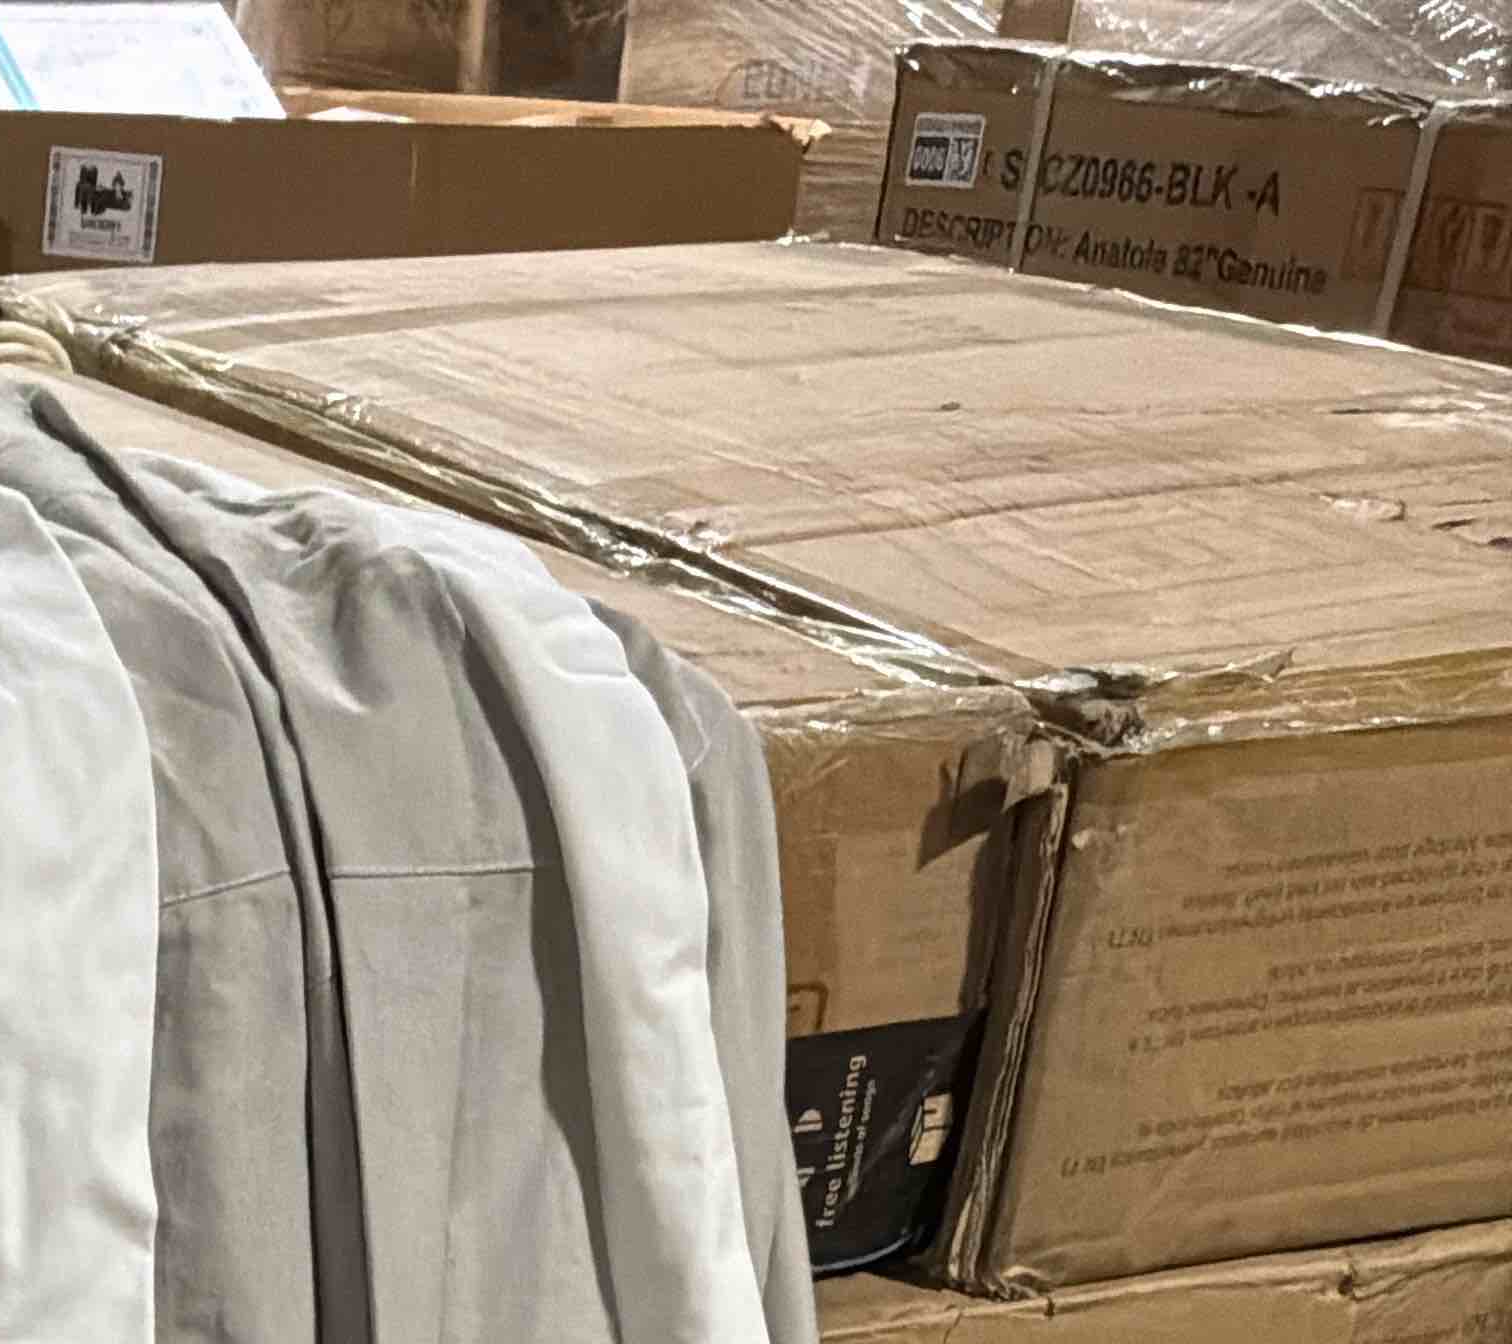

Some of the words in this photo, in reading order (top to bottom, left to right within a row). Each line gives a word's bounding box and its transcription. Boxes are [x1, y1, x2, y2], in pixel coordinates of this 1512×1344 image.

[1000, 148, 1238, 210] SCZ0966-BLK
[902, 207, 1070, 259] DESCRIPTON:
[825, 1055, 868, 1172] listening
[815, 1176, 842, 1228] free
